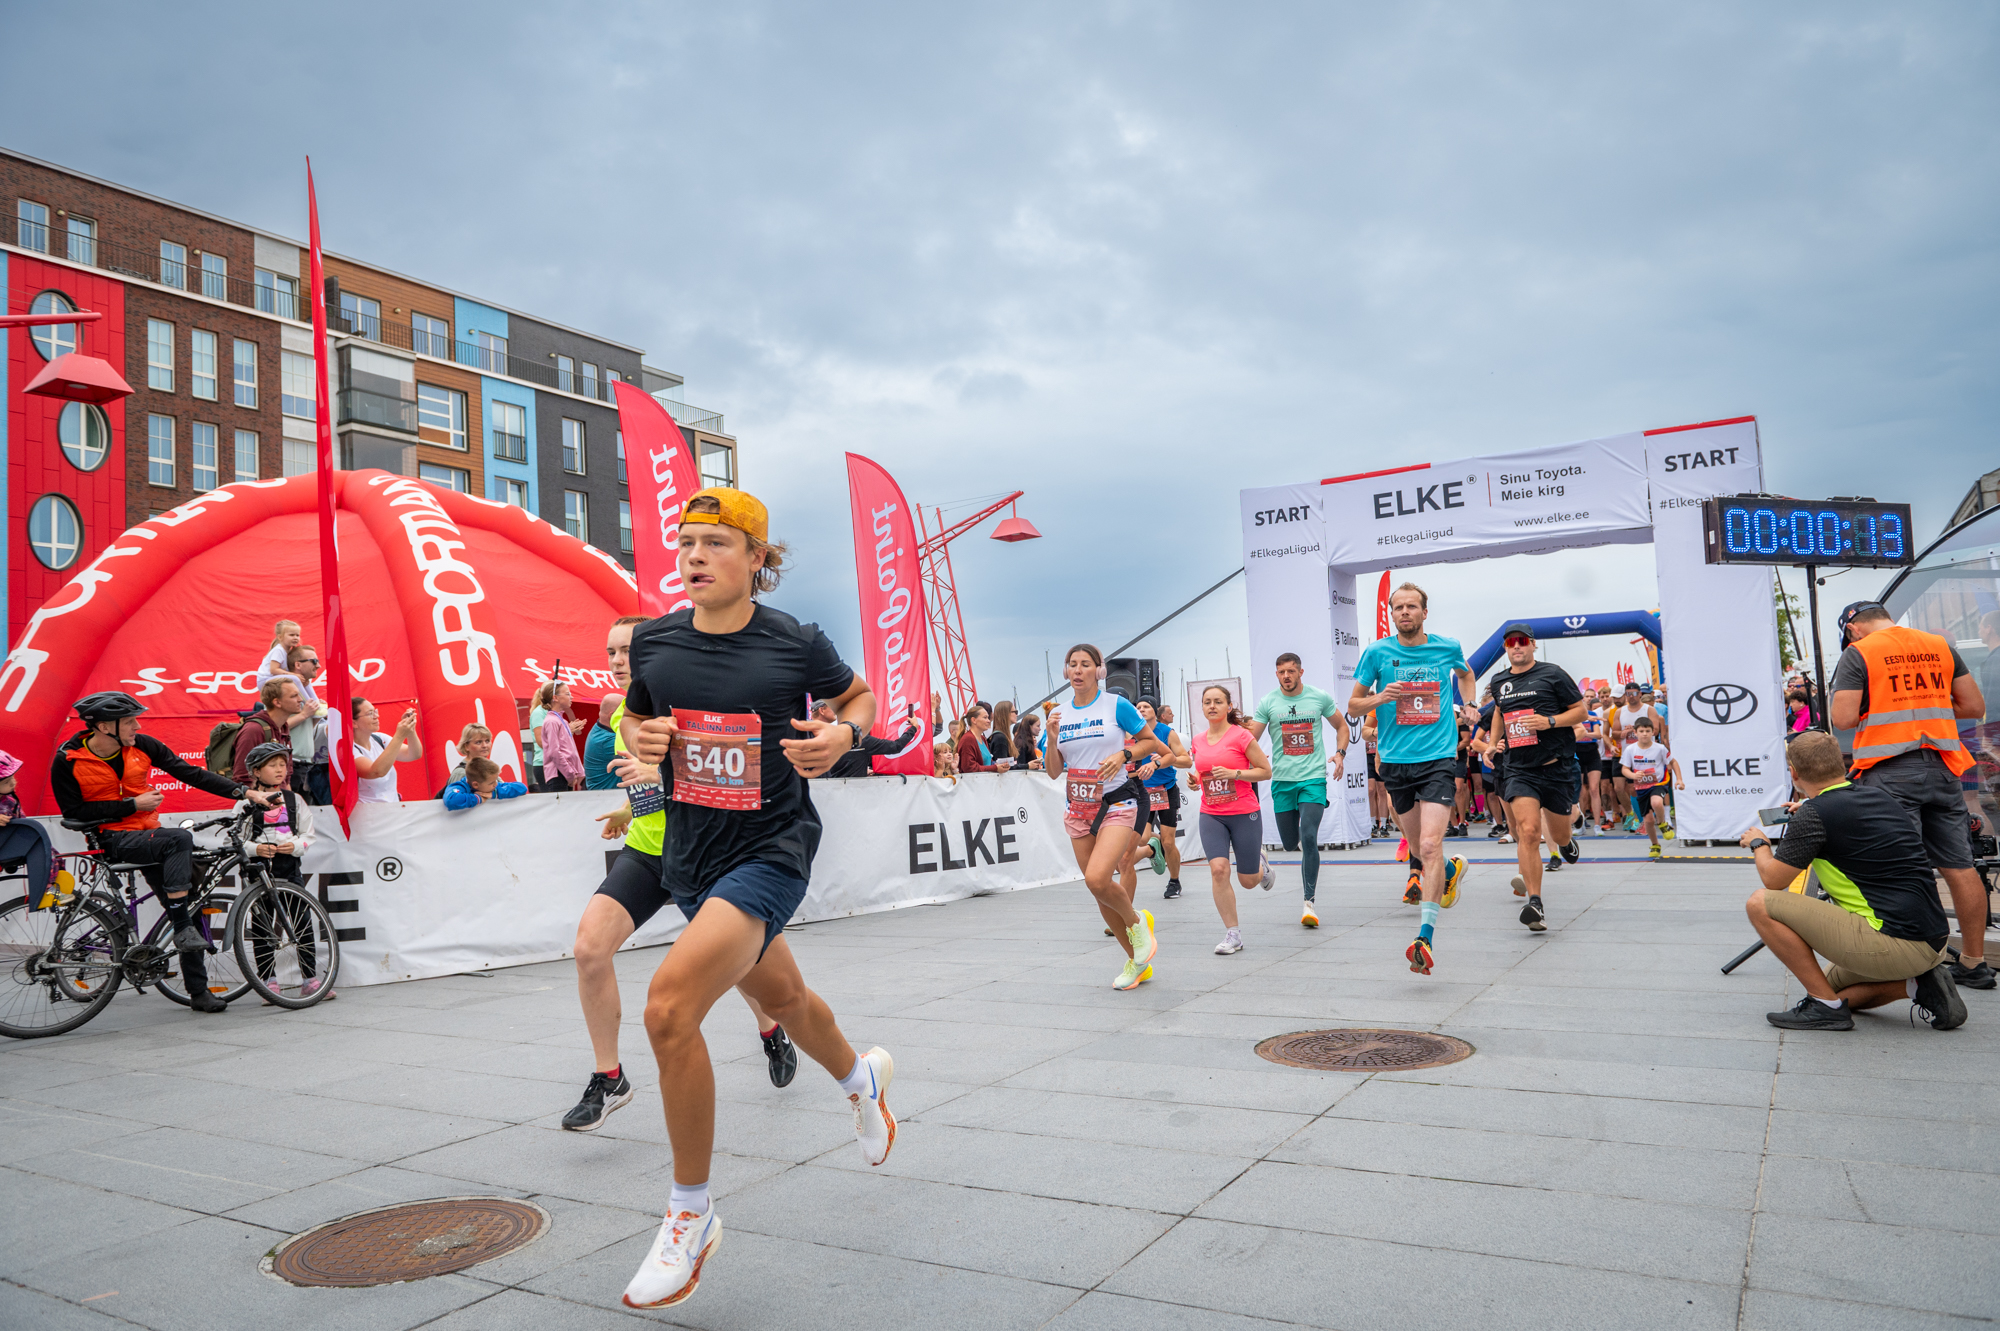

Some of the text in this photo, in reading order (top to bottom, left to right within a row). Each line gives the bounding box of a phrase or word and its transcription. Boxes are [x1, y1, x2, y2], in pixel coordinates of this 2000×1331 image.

[1664, 447, 1739, 472] START
[1500, 465, 1586, 486] Sinu Toyota.
[1501, 484, 1565, 501] Meie kirg
[1255, 505, 1310, 526] START
[1514, 510, 1589, 527] www.elke.ee
[1377, 527, 1454, 546] #ElkegaLiigud
[1725, 508, 1903, 558] 00:00:13
[1250, 542, 1320, 558] #ElkegaLiigud
[1340, 631, 1358, 647] Tallinn
[1884, 655, 1905, 665] EESTI
[1394, 667, 1439, 681] BORN
[1889, 672, 1945, 692] TEAM
[1413, 696, 1423, 710] 6
[686, 721, 746, 733] TALLINN RUN
[1291, 734, 1306, 745] 36
[686, 744, 745, 777] 540
[715, 776, 744, 785] 10 km
[1209, 779, 1228, 792] 487
[1070, 783, 1096, 798] 367
[1695, 786, 1764, 796] www.elke.ee
